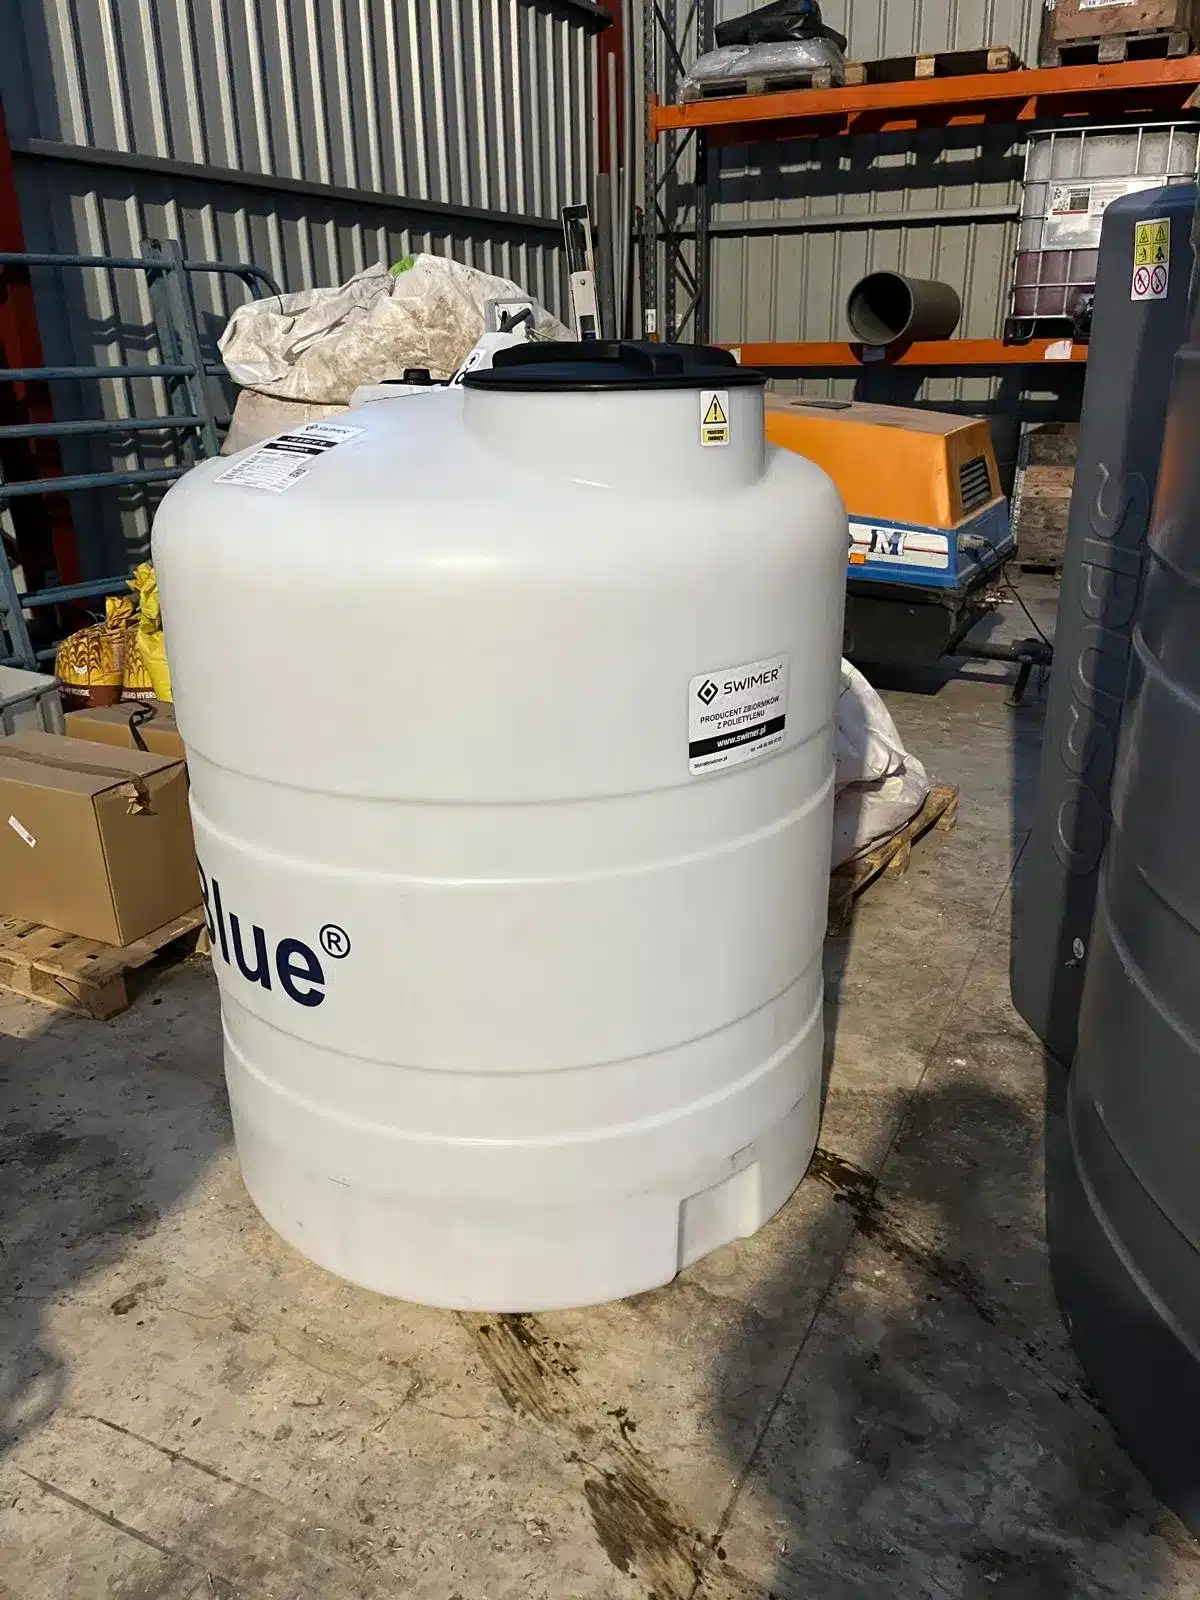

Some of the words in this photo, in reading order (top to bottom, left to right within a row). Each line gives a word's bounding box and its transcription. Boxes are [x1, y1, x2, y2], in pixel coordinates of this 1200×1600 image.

[723, 668, 779, 695] SWIMER
[700, 706, 743, 724] PRODUCENT
[743, 695, 780, 714] ZBIORNIKÓW
[717, 722, 722, 730] Z
[722, 709, 766, 728] POLIETYLENU
[716, 724, 767, 748] www.swimer.pl
